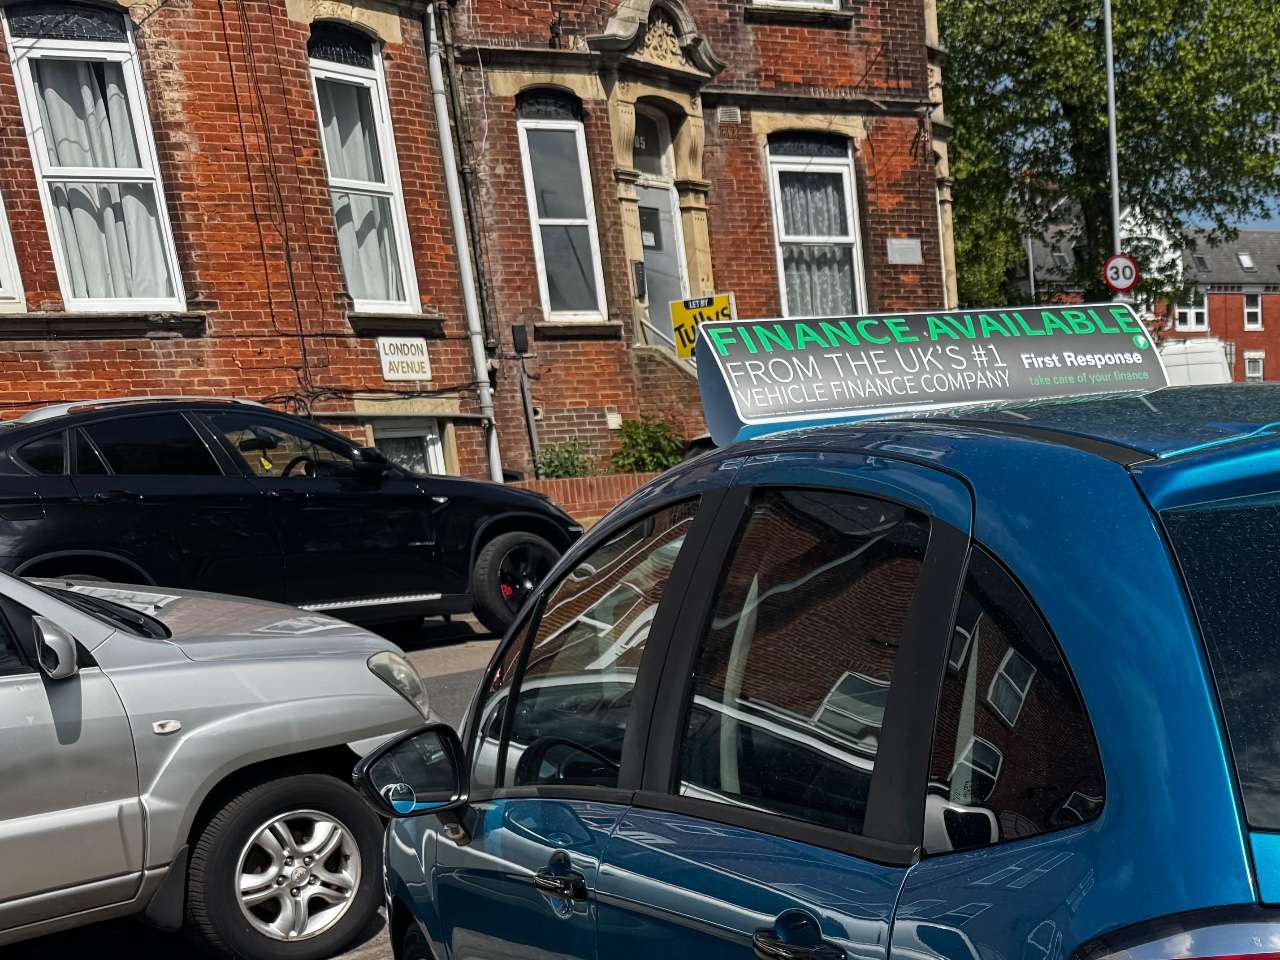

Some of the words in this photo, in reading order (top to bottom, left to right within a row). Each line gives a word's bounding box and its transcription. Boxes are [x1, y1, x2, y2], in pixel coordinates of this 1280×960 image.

[1109, 265, 1133, 281] 30
[688, 300, 699, 308] LET
[700, 299, 709, 307] BY
[708, 318, 919, 357] FINANCE
[927, 307, 1142, 341] AVAILABLE
[382, 343, 424, 356] LONDON
[388, 360, 427, 374] AVENUE
[726, 355, 822, 387] FROM
[824, 350, 893, 378] THE
[895, 345, 967, 372] UK'S
[972, 344, 1007, 369] #1
[1021, 352, 1059, 369] First
[1063, 350, 1143, 369] Response
[1029, 372, 1050, 386] take
[1053, 373, 1075, 385] care
[1077, 371, 1087, 383] of
[1089, 372, 1111, 386] your
[1114, 369, 1149, 382] finance
[737, 381, 828, 408] VEHICLE
[831, 375, 918, 400] FINANCE
[921, 369, 1010, 393] COMPANY
